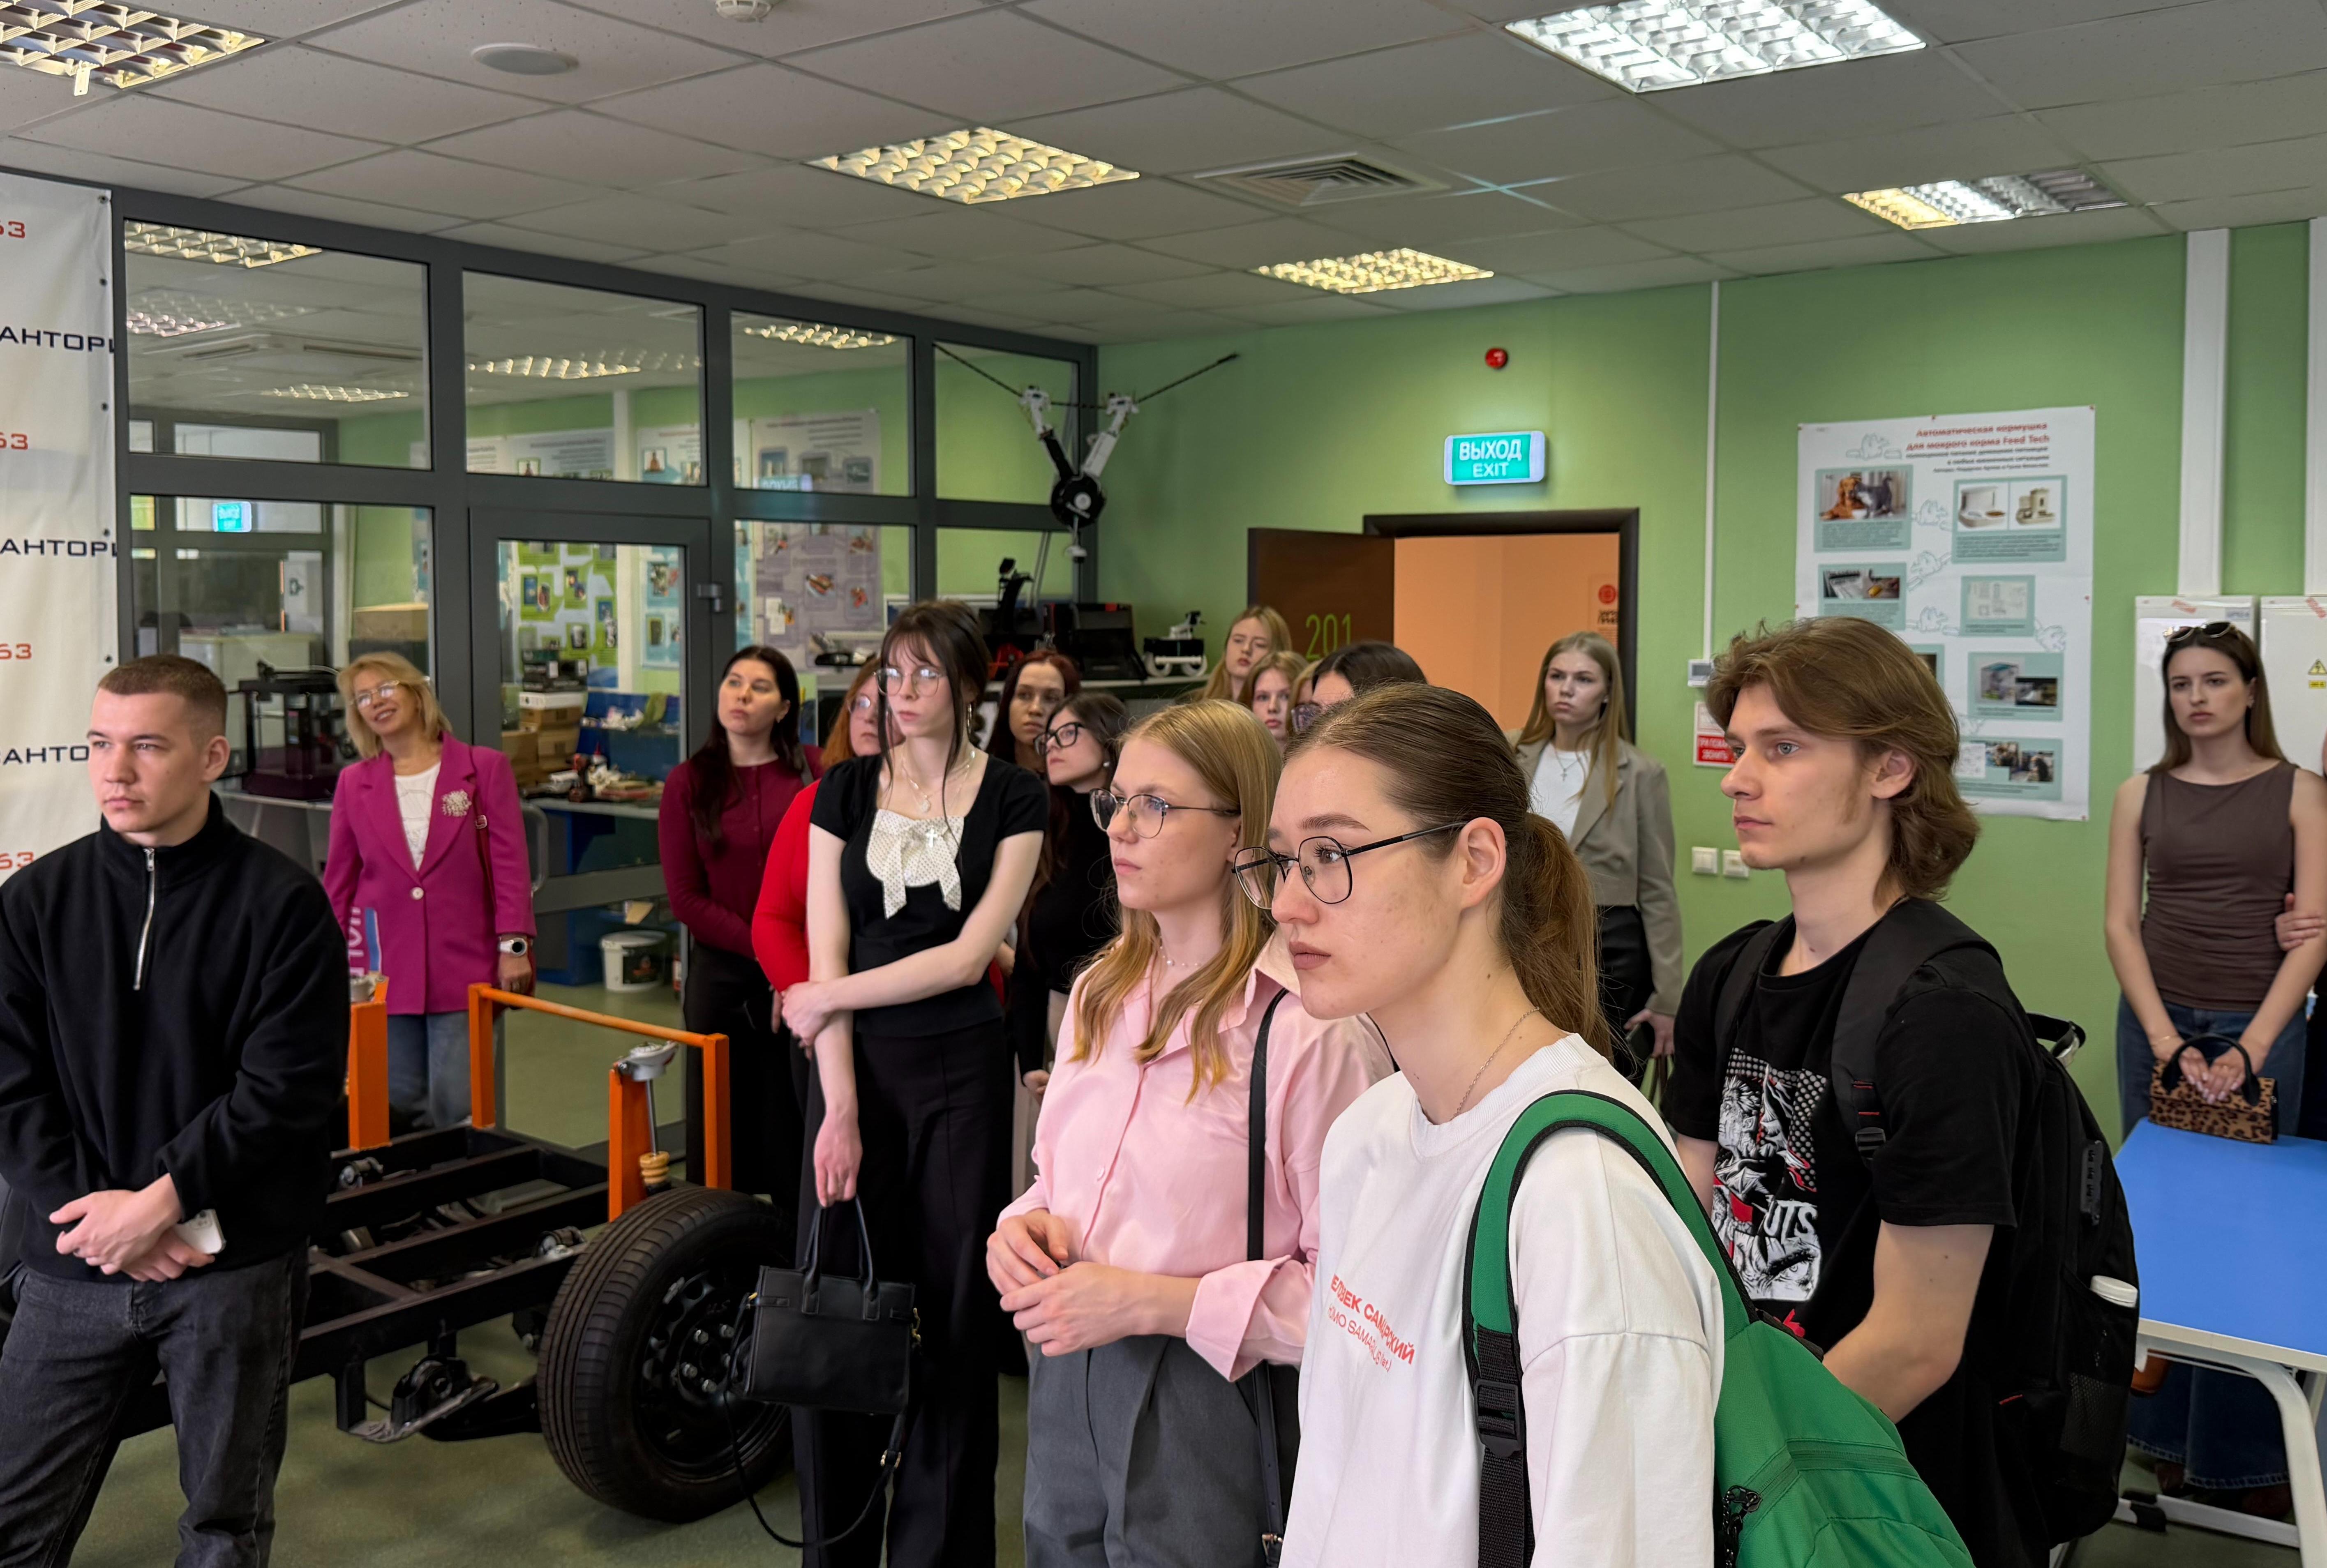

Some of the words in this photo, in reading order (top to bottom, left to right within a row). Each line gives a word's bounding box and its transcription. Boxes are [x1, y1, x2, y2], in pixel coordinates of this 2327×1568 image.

[0, 220, 25, 239] 3
[0, 326, 115, 353] АНТОР
[1916, 426, 1994, 438] Автоматическая
[1996, 423, 2048, 433] кормушка
[1459, 439, 1522, 461] ВЫХОД
[1907, 440, 1924, 450] для
[1927, 439, 1967, 449] мокрого
[1970, 438, 2000, 447] корма
[2003, 436, 2026, 444] Feed
[2029, 434, 2050, 443] Tech
[1473, 462, 1509, 478] EXIT
[0, 539, 117, 557] АНТОР
[1306, 614, 1350, 659] 201
[0, 643, 32, 660] 63
[0, 745, 90, 766] АНТО
[0, 851, 34, 870] 63
